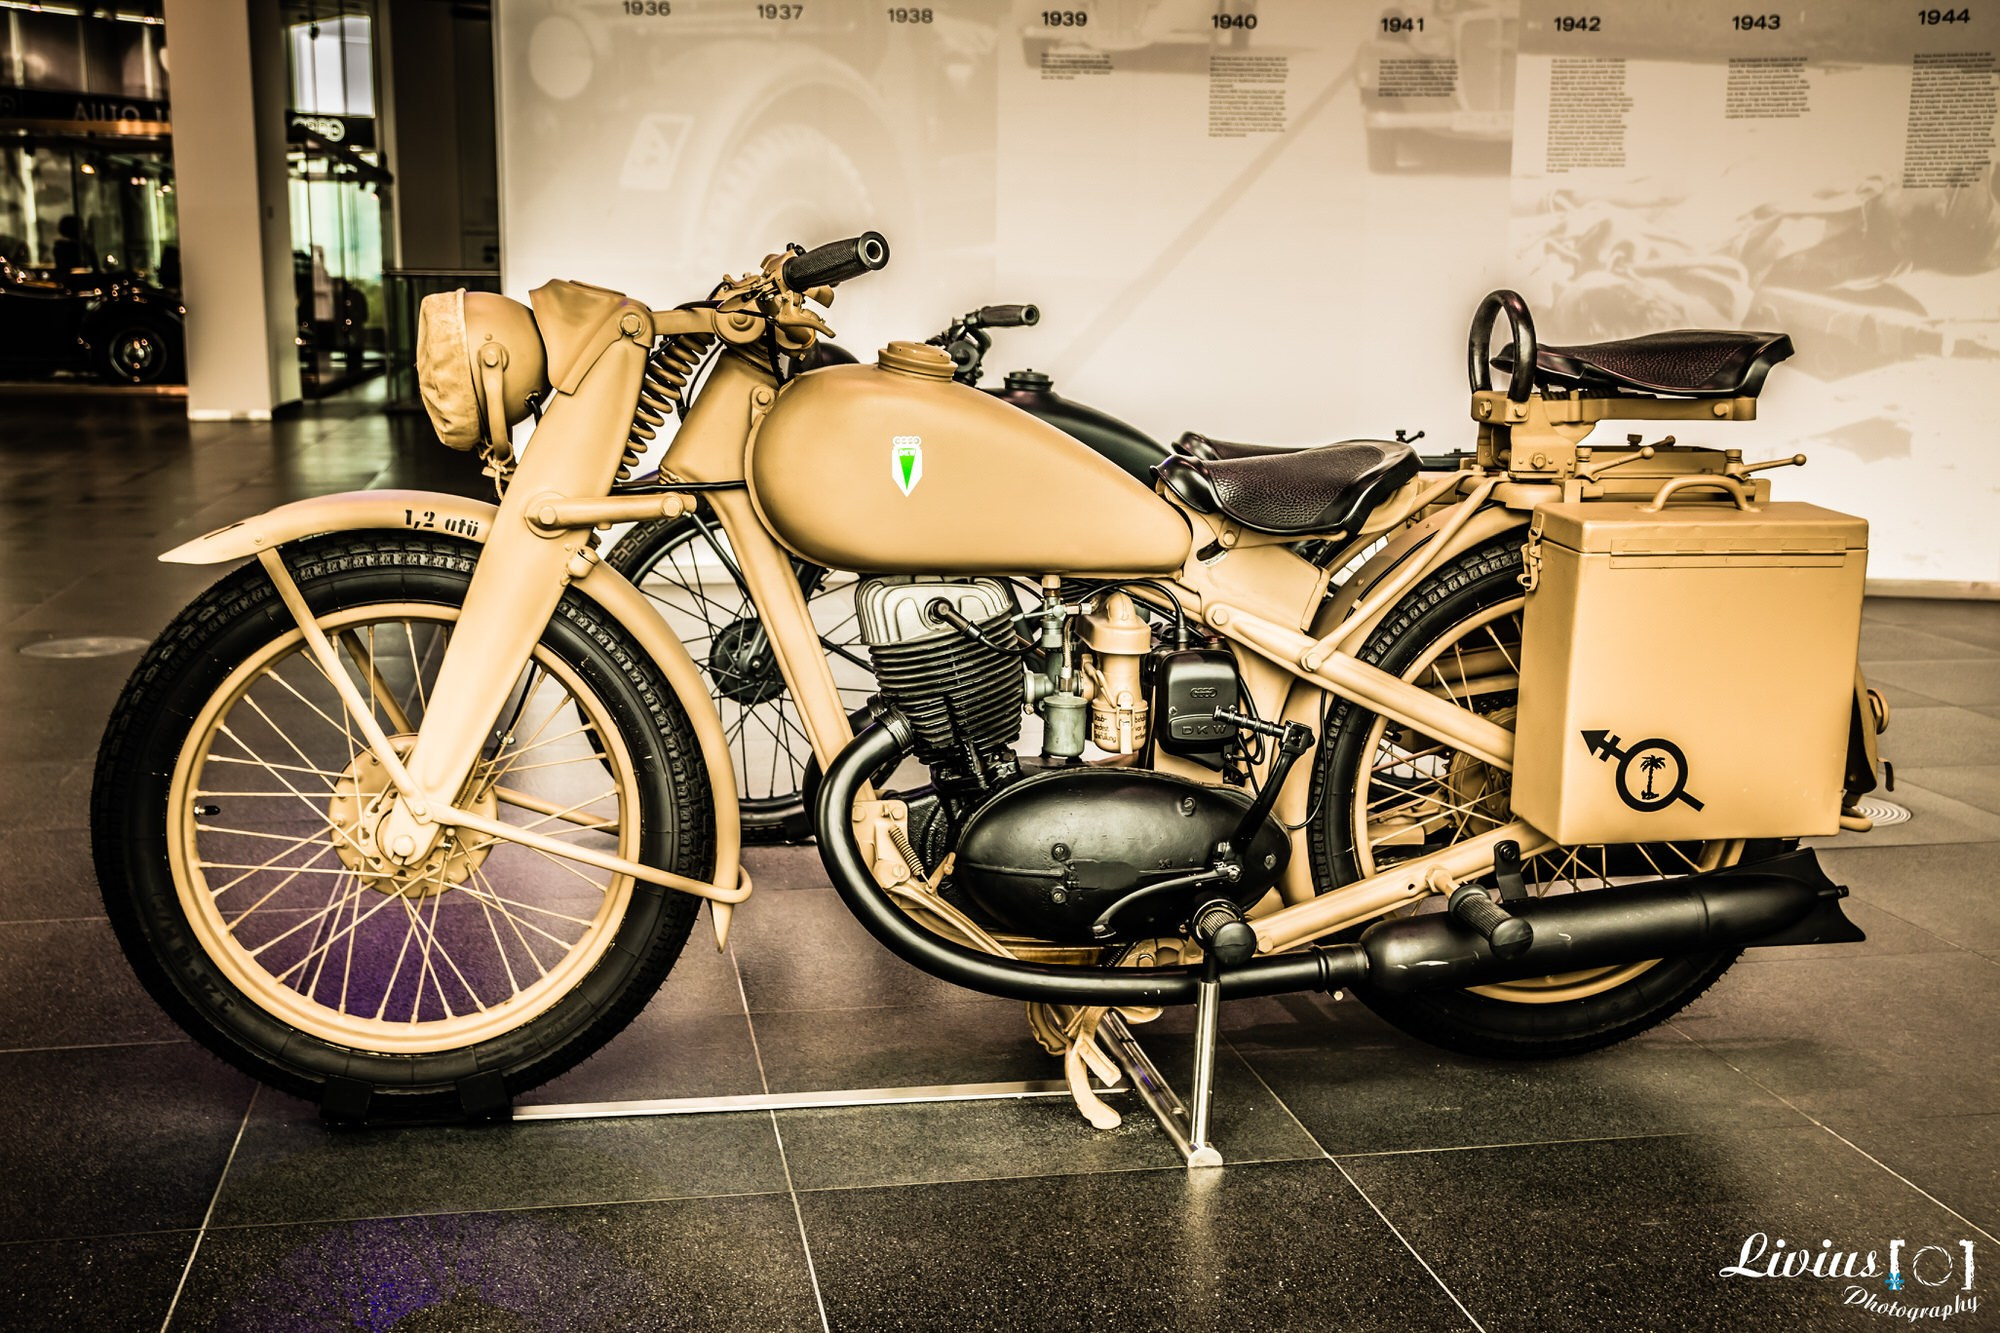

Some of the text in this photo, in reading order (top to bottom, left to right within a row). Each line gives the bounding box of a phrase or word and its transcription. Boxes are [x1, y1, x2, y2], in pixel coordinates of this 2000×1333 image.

[622, 0, 671, 16] 1936
[757, 4, 803, 20] 1937
[887, 8, 934, 24] 1938
[1042, 11, 1088, 27] 1939
[1211, 13, 1258, 30] 1940
[1554, 16, 1601, 32] 1942
[1733, 15, 1781, 31] 1943
[1918, 8, 1971, 25] 1944
[1381, 17, 1424, 33] 1941
[404, 509, 436, 530] 1,2
[1181, 724, 1227, 736] DKW
